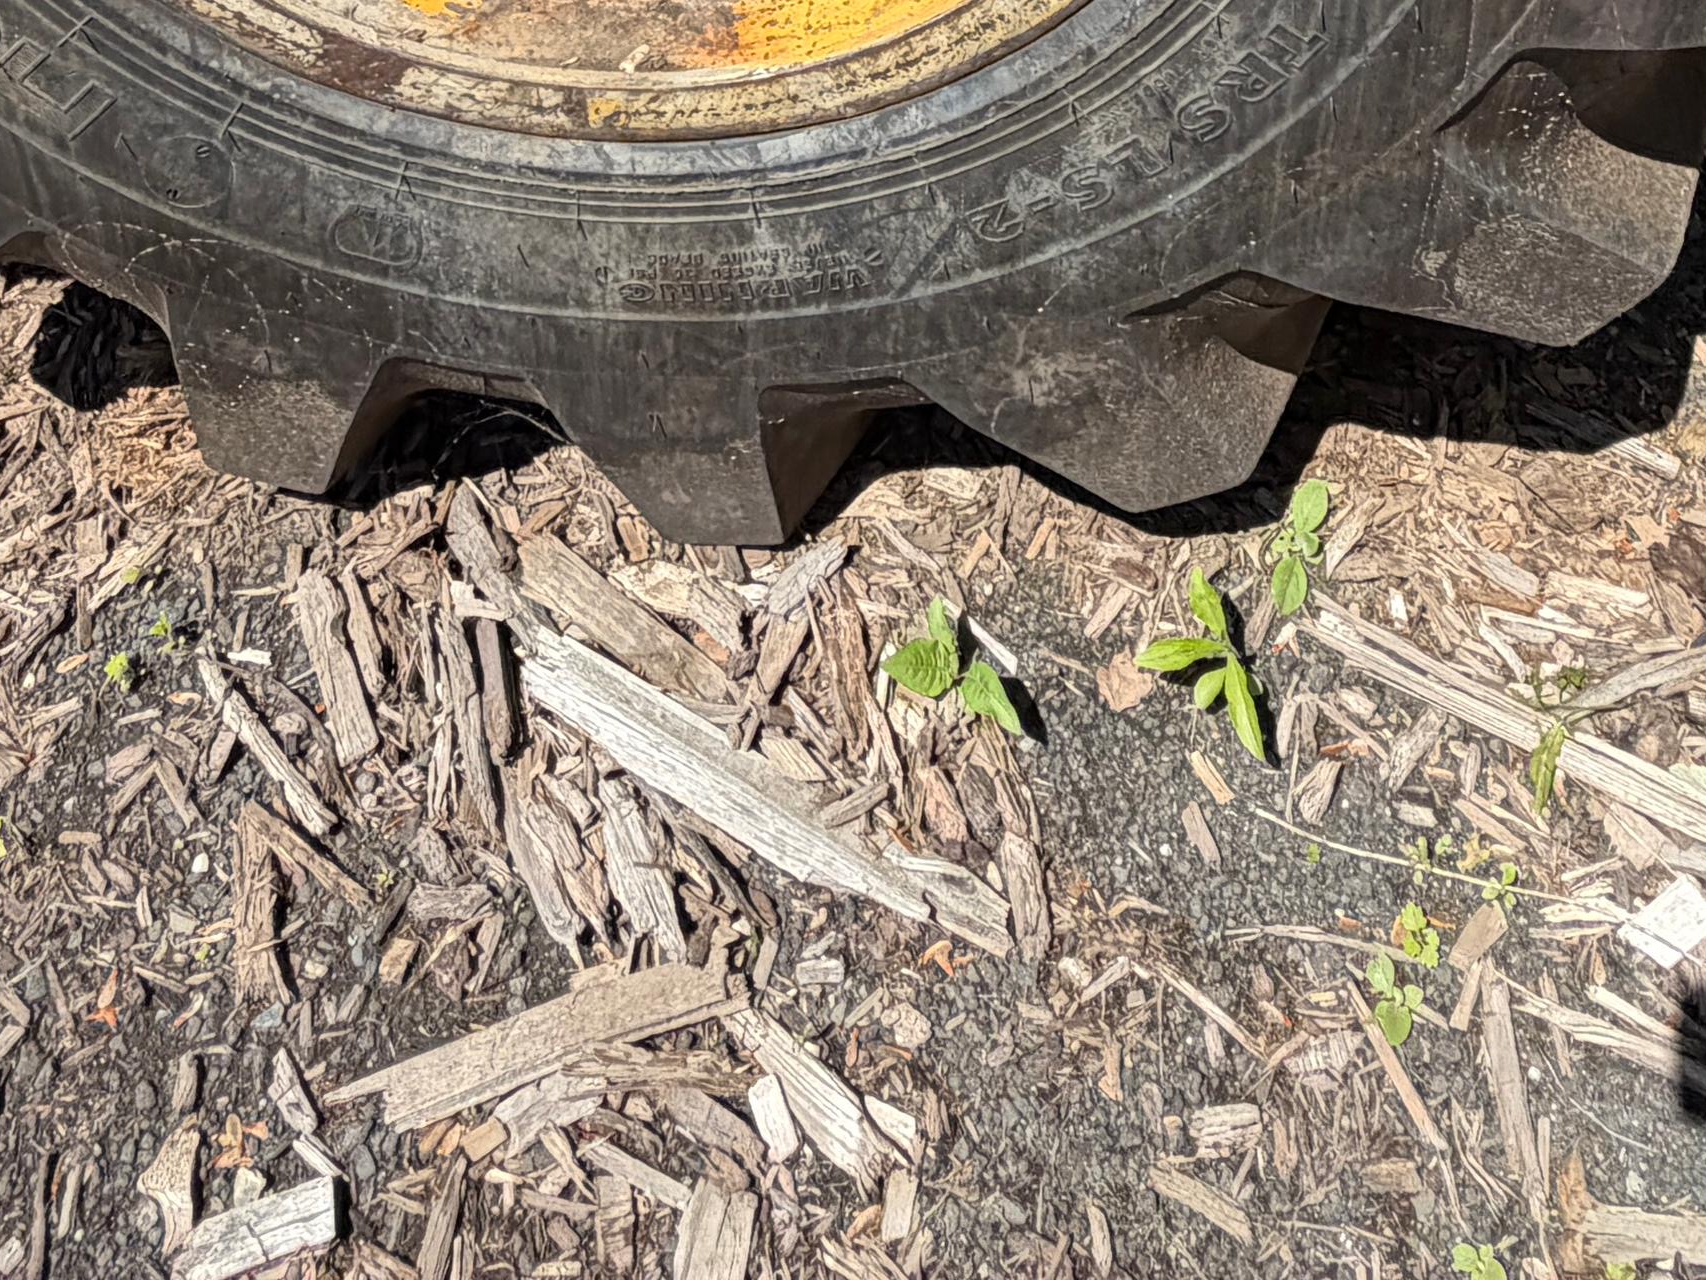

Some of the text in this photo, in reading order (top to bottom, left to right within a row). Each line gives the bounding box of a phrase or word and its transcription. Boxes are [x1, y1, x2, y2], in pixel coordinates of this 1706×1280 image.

[966, 23, 1328, 243] TRS LS-2
[618, 264, 871, 302] WARNING
